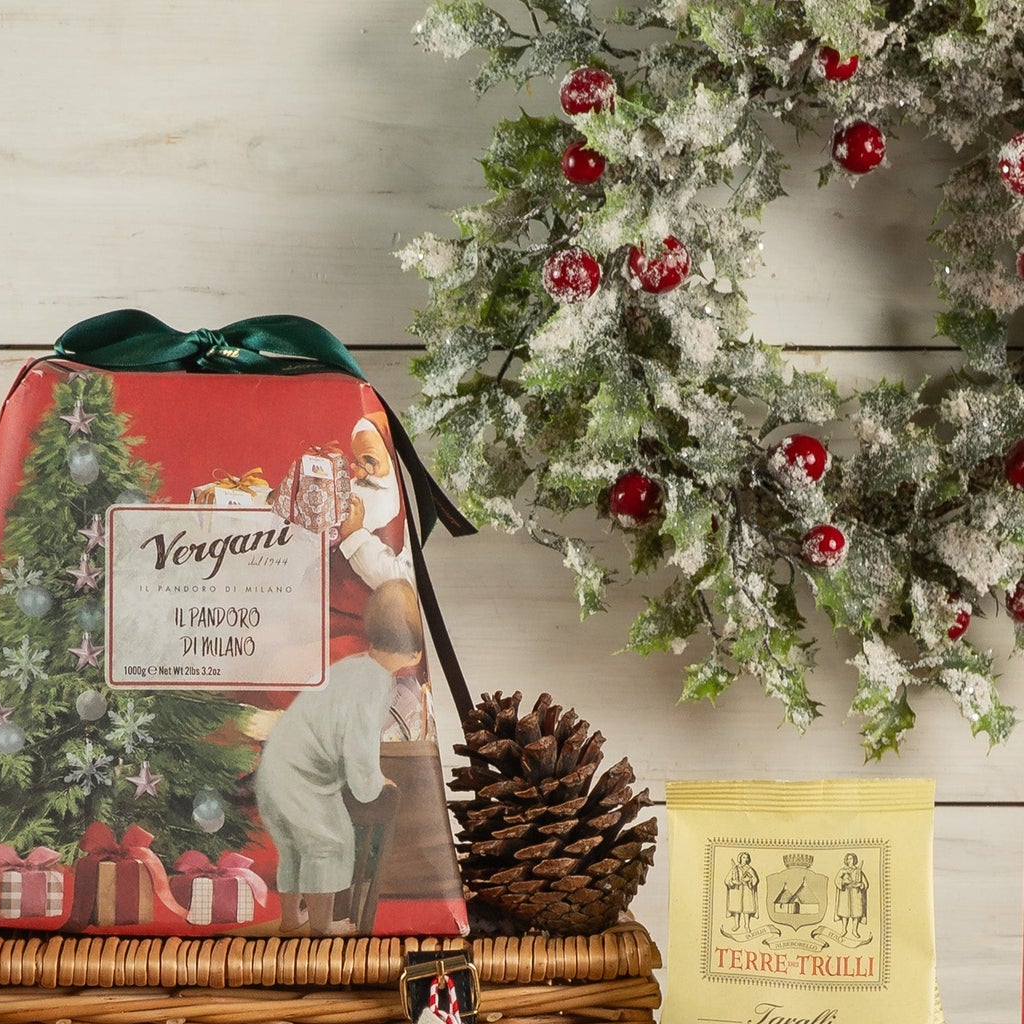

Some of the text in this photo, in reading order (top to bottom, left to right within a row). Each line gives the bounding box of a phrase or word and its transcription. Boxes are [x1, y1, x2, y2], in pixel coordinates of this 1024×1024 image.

[140, 520, 293, 581] Vergani
[139, 585, 150, 593] IL
[158, 585, 217, 593] PANDORO
[175, 607, 261, 629] IL PANDORO
[180, 636, 256, 657] DI MILANO
[124, 666, 146, 677] 1000g
[158, 666, 172, 676] Net
[173, 666, 184, 676] Wt
[185, 666, 200, 676] 2lbs
[201, 666, 221, 676] 3.2oz
[715, 946, 788, 975] TERRE
[796, 954, 875, 977] TRULLI
